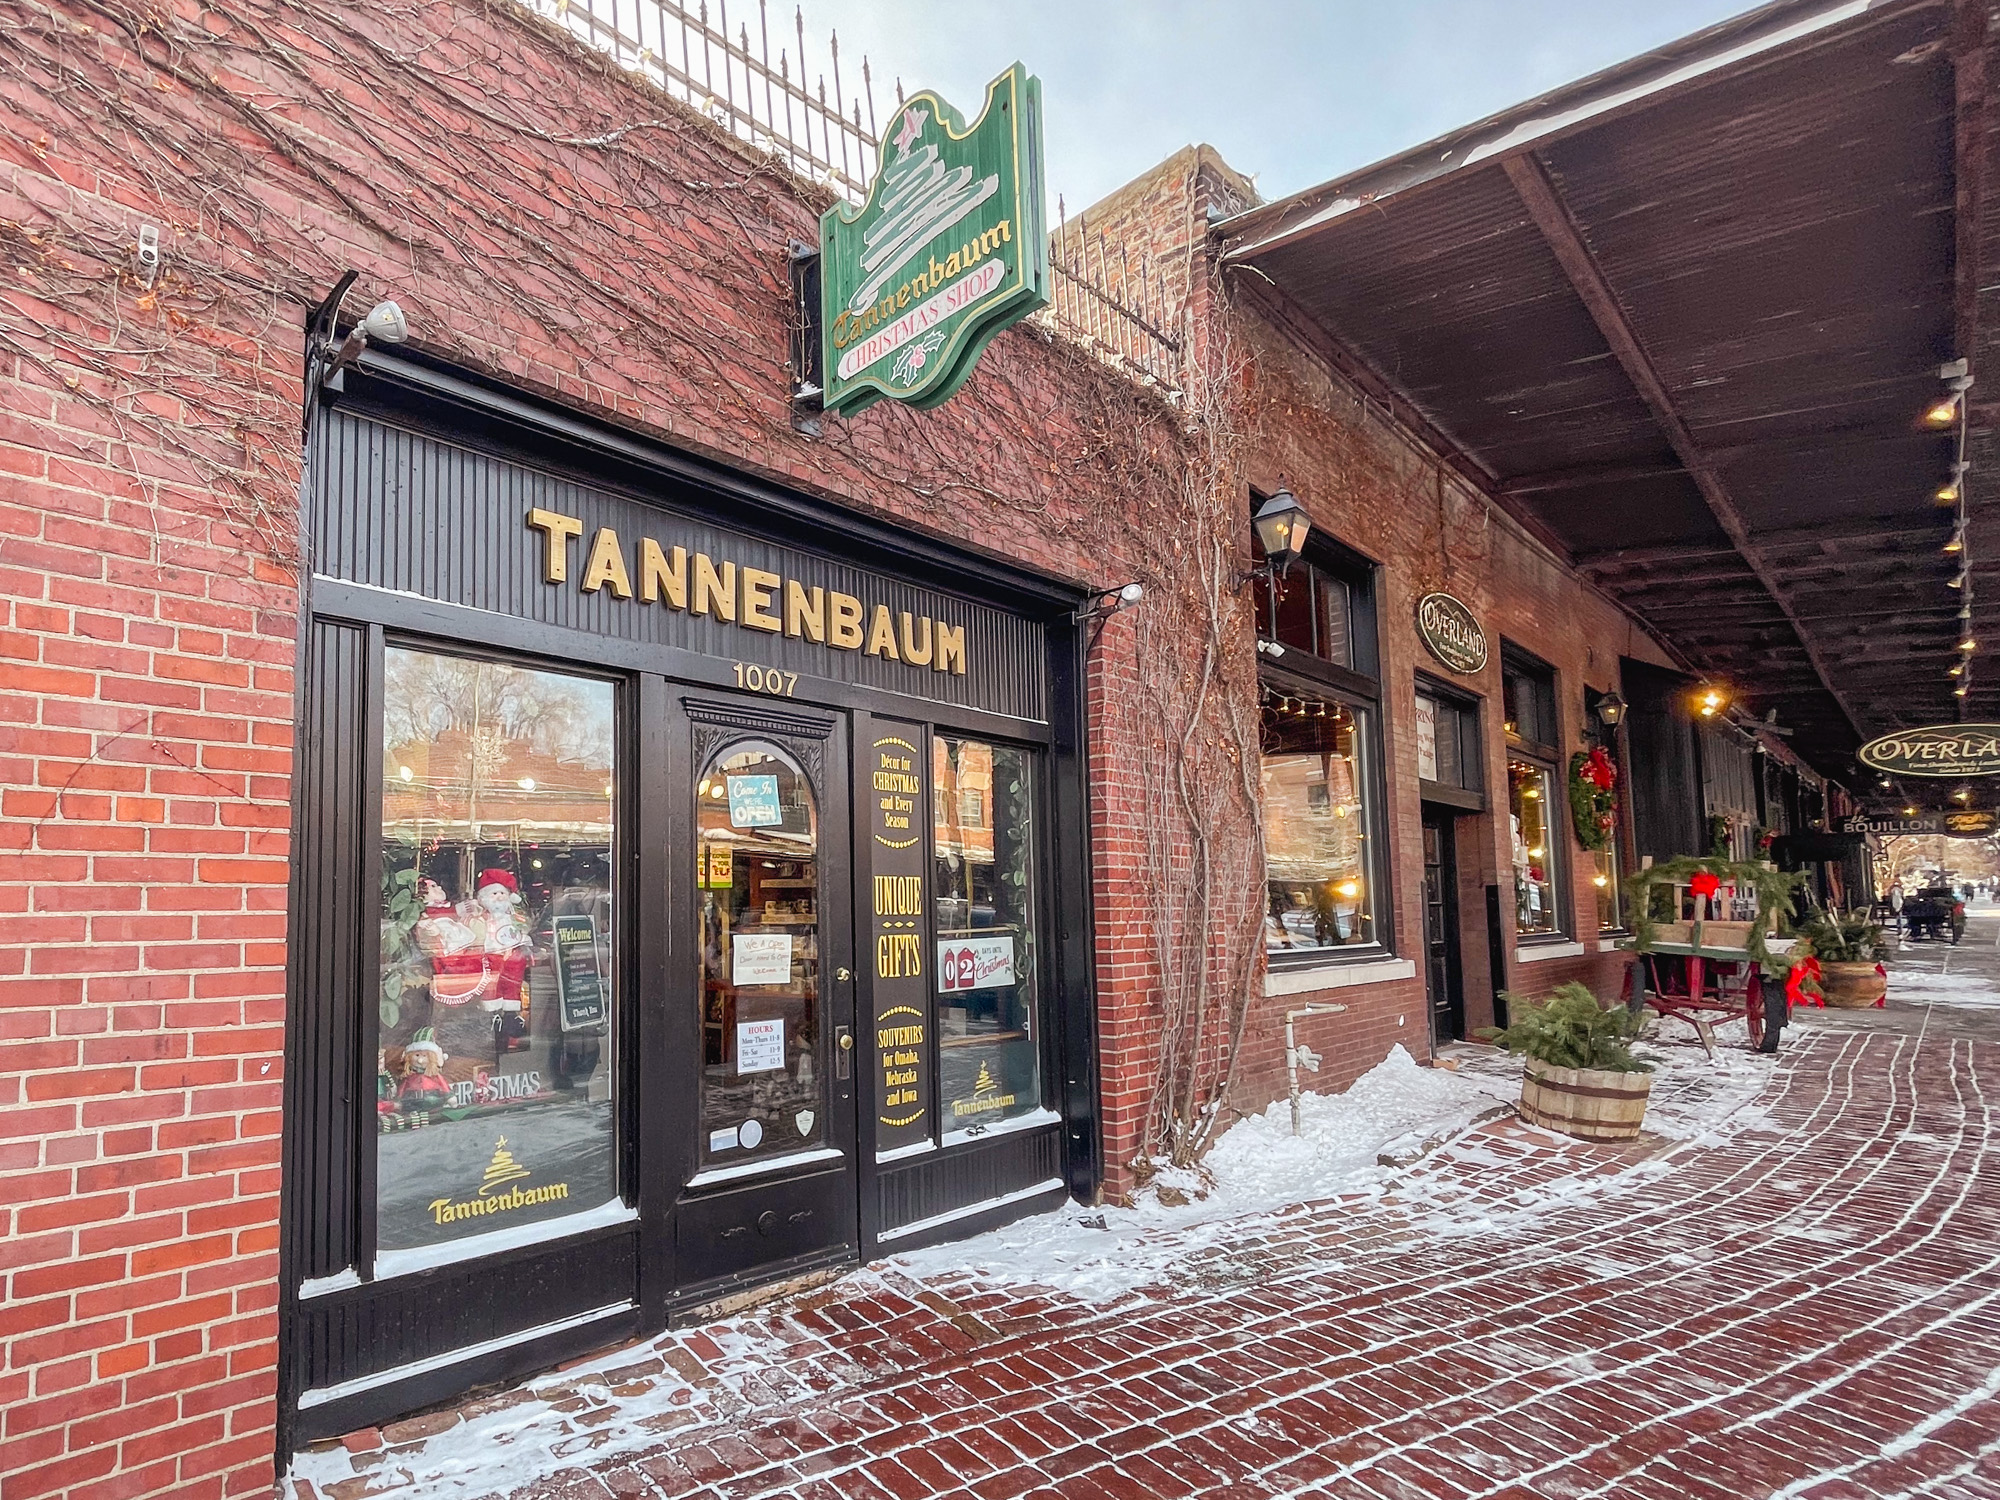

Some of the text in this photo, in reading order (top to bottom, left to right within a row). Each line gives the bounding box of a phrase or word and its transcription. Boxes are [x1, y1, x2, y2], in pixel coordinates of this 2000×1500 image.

[832, 219, 1012, 349] Tannenbaum
[845, 265, 995, 374] CHRISTMAS SHOP
[527, 507, 966, 675] TANNENBAUM
[1424, 601, 1484, 657] OVERLAND
[733, 662, 798, 697] 1007
[881, 753, 911, 771] Décor for
[734, 781, 772, 798] Come In
[873, 771, 919, 794] CHRISTMAS
[735, 805, 777, 822] OPEN
[880, 795, 913, 814] and Every
[885, 812, 909, 829] Season
[1843, 820, 1937, 833] BOUILLON
[874, 876, 922, 915] UNIQUE
[559, 927, 592, 942] Welcome
[877, 934, 921, 978] GIFTS
[974, 954, 1009, 980] Christmas
[748, 1025, 774, 1035] HOURS
[878, 1025, 923, 1048] SOUVENIRS
[883, 1049, 919, 1068] for Omaha,
[886, 1068, 917, 1087] Nebraska
[886, 1088, 917, 1106] and Iowa
[951, 1094, 1015, 1116] Tannenbaum
[428, 1183, 569, 1224] Tannenbaum
